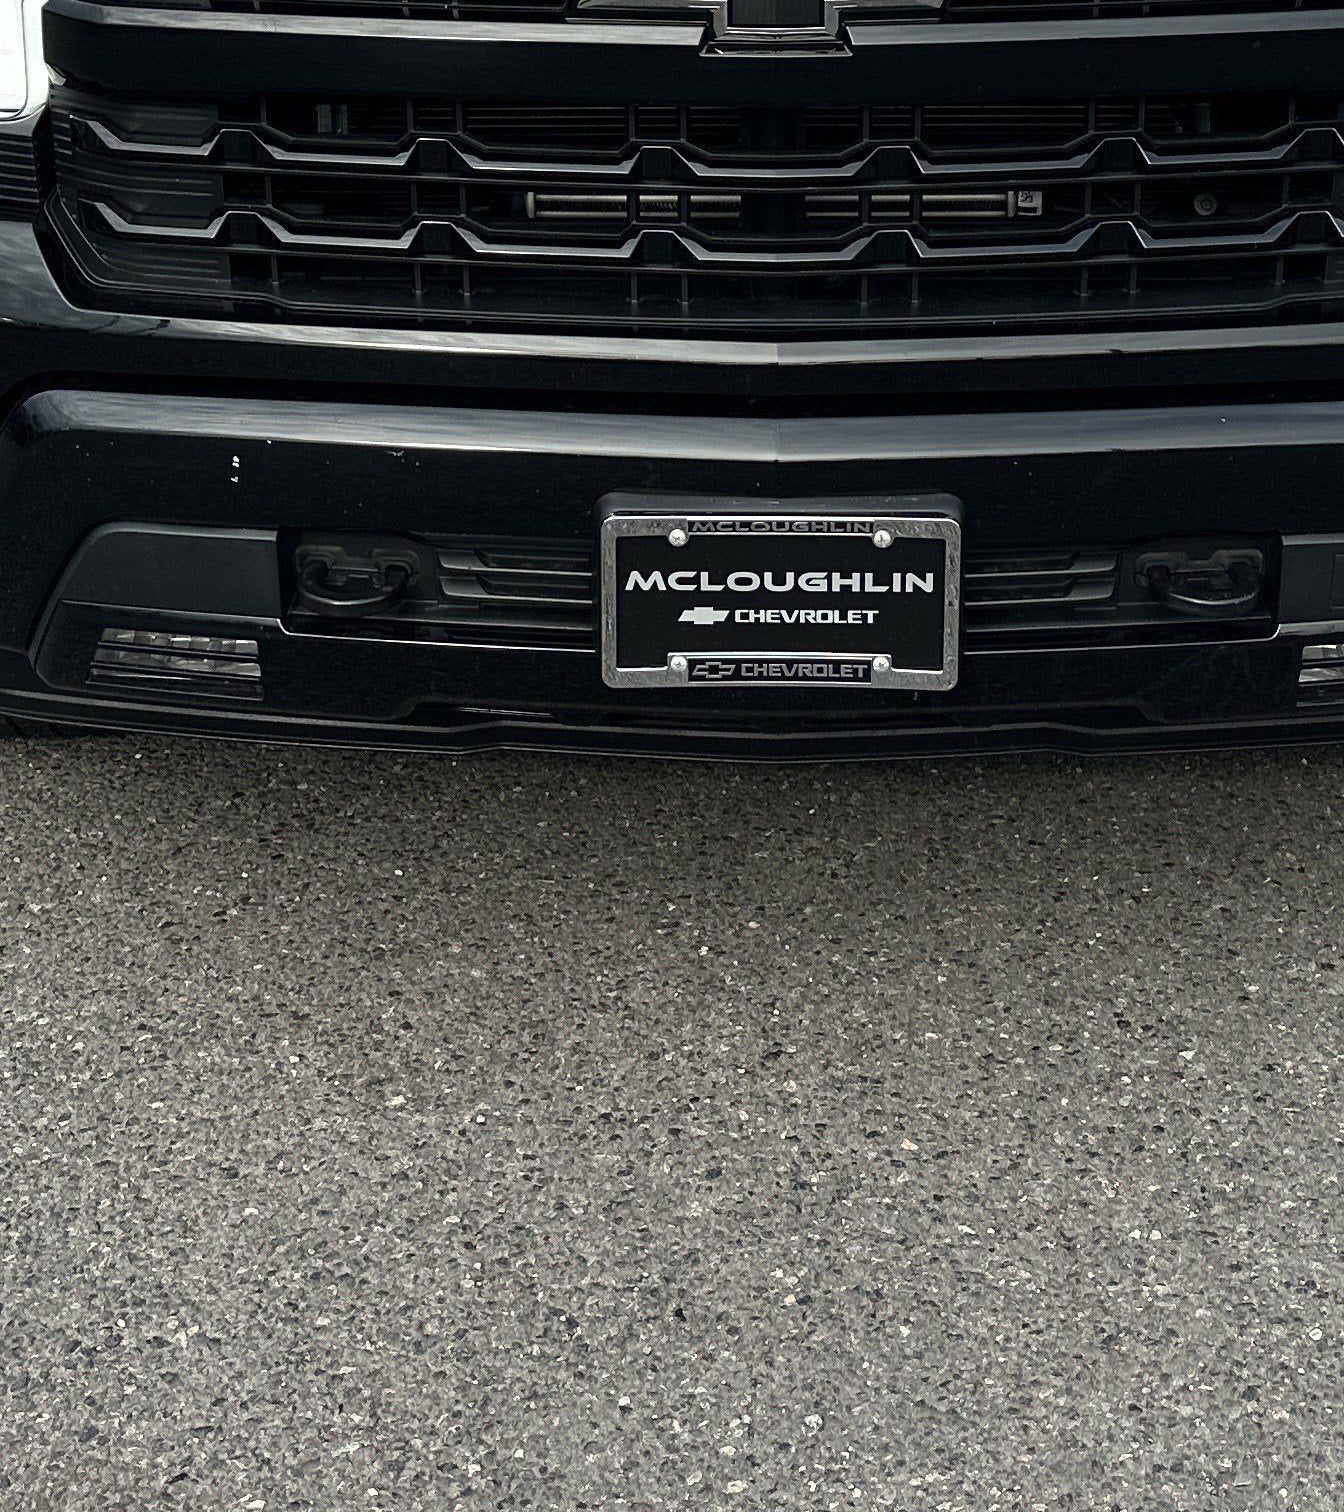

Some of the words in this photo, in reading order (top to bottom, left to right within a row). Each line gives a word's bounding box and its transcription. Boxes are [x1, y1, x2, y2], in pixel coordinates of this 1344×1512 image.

[691, 521, 872, 534] MCLOUGHLIN
[624, 570, 935, 593] MCLOUGHLIN
[734, 608, 879, 624] CHEVROLET
[740, 662, 868, 679] CHEVROLET
